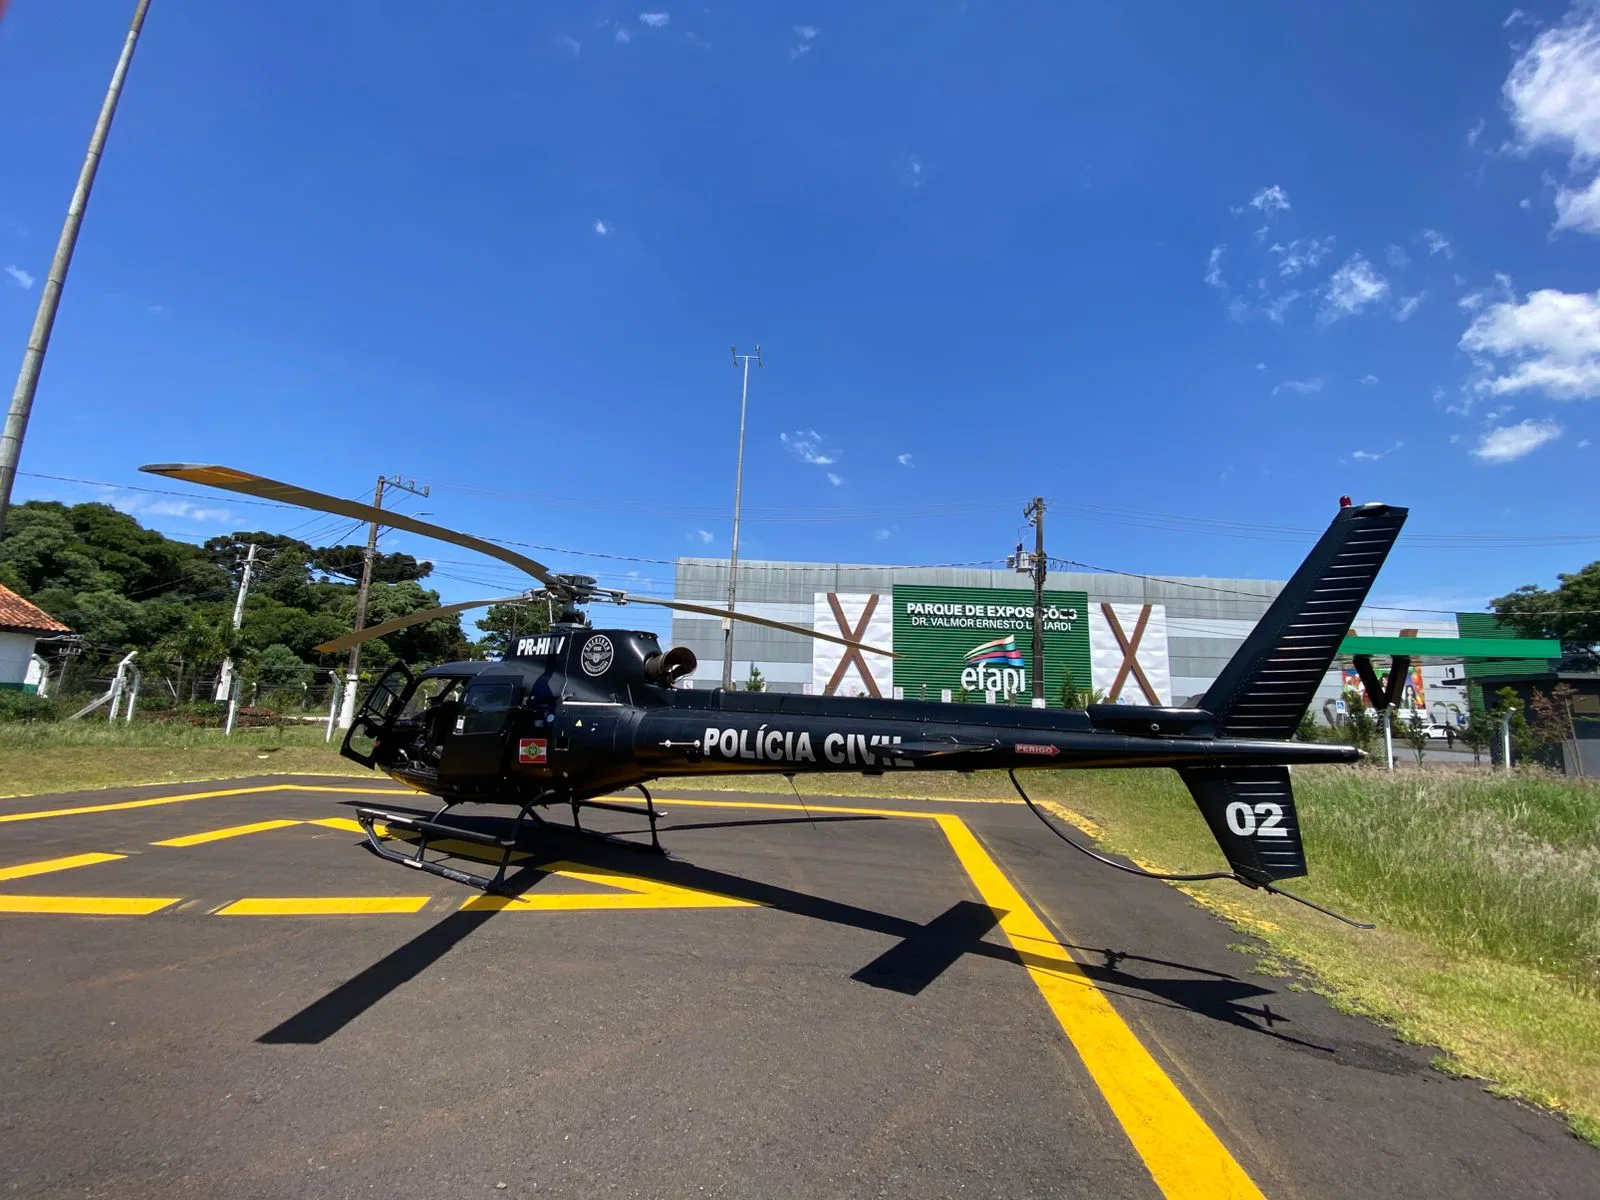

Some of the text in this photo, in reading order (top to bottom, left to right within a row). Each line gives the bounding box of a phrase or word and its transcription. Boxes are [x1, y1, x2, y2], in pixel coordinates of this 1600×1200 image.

[907, 603, 1077, 621] PARQUE DE EXPOSÇÕES
[912, 617, 1071, 631] DR. VALMOR ERNESTO LARDI
[516, 636, 566, 656] PR-HHV
[961, 661, 1025, 700] efapi
[704, 724, 816, 762] POLÍCIA
[1016, 745, 1053, 754] PERIGO
[1226, 802, 1287, 836] 02
